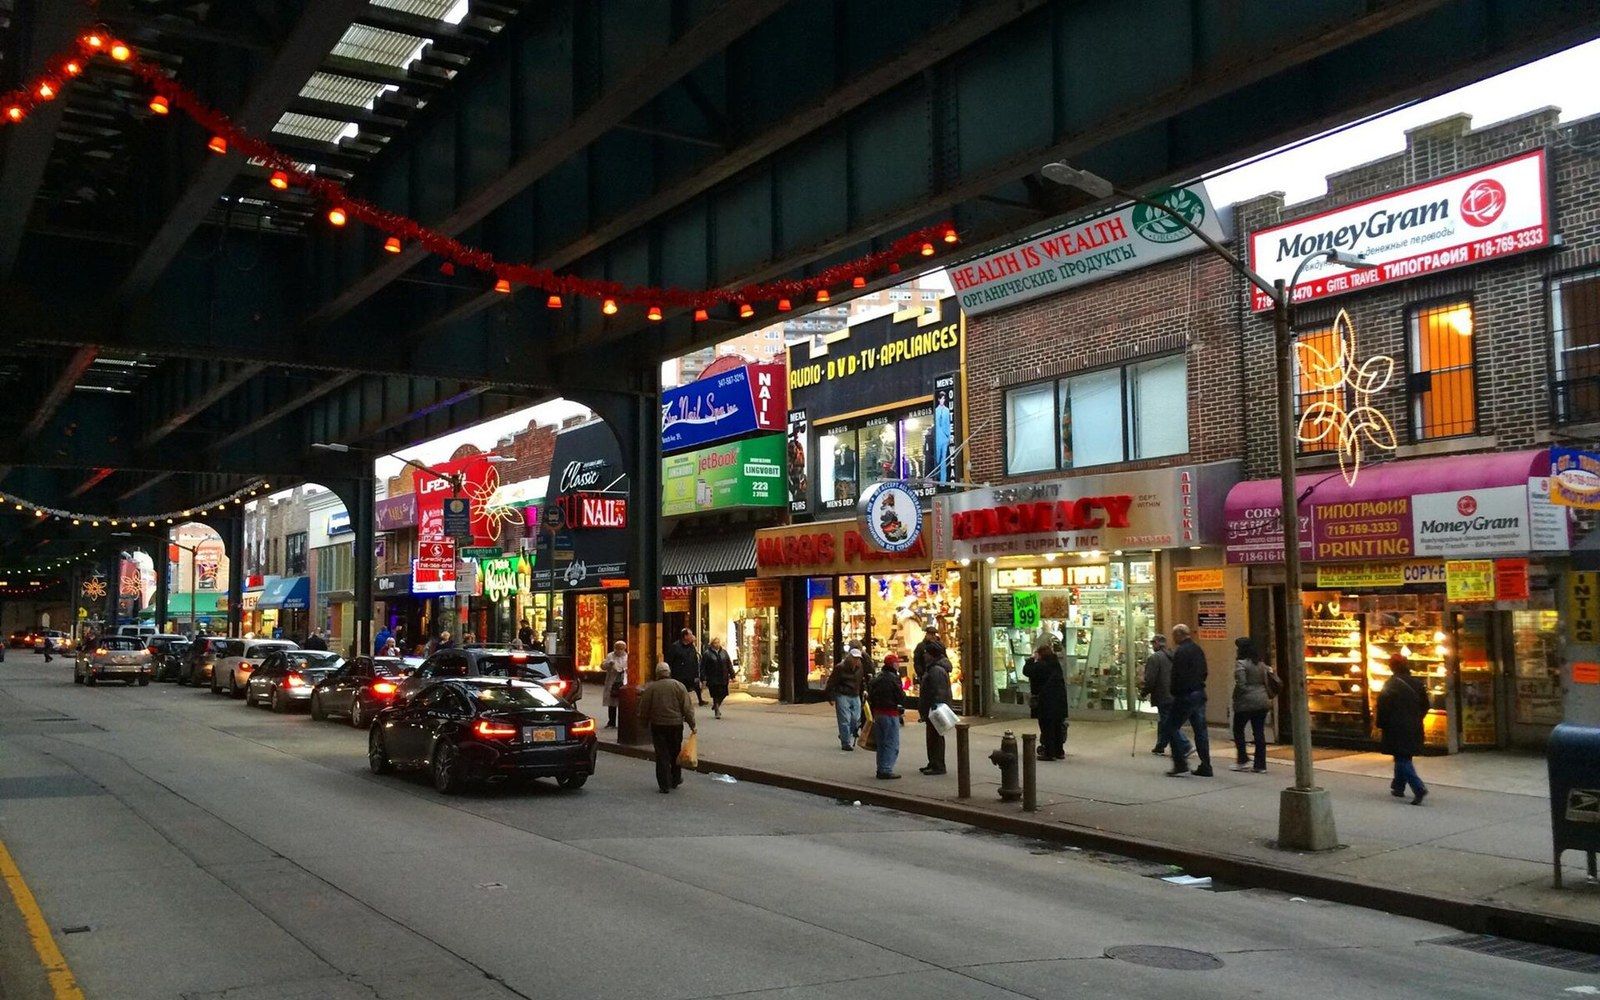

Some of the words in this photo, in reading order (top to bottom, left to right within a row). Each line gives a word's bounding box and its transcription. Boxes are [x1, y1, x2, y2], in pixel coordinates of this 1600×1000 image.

[1276, 198, 1449, 262] MoneyGram
[952, 252, 1021, 291] HEALTH
[1024, 245, 1042, 269] IS
[1040, 217, 1128, 261] WEALTH
[1350, 269, 1380, 287] TRAVEL
[1384, 247, 1469, 279] ТИПОГРАФИЯ
[1474, 228, 1543, 259] 718-769-3333
[963, 269, 1058, 308] ОРГАНИЧЕСКИЕ
[1060, 243, 1137, 279] ПРОДУКТЫ
[790, 364, 821, 389] AUDIO
[861, 348, 875, 371] TV
[880, 324, 958, 366] APPLIANCES
[936, 378, 953, 388] MEN'S
[759, 372, 771, 425] NAIL
[679, 395, 702, 421] Nail
[705, 392, 726, 425] Spa
[908, 408, 933, 418] NARGIS
[561, 461, 599, 493] Classic
[745, 467, 779, 476] LINGVOBIT
[752, 482, 768, 491] 223
[583, 499, 618, 526] NAIL
[791, 501, 806, 511] FURS
[826, 500, 842, 509] MEN'S
[1245, 508, 1281, 519] CORA
[1317, 499, 1407, 519] ТИПОГРАФИЯ
[1328, 522, 1397, 535] 718-769-3333
[1420, 516, 1519, 534] MoneyGram
[1025, 537, 1069, 550] SUPPLY
[1076, 536, 1098, 547] INC
[1319, 538, 1409, 557] PRINTING
[1019, 608, 1035, 624] 99
